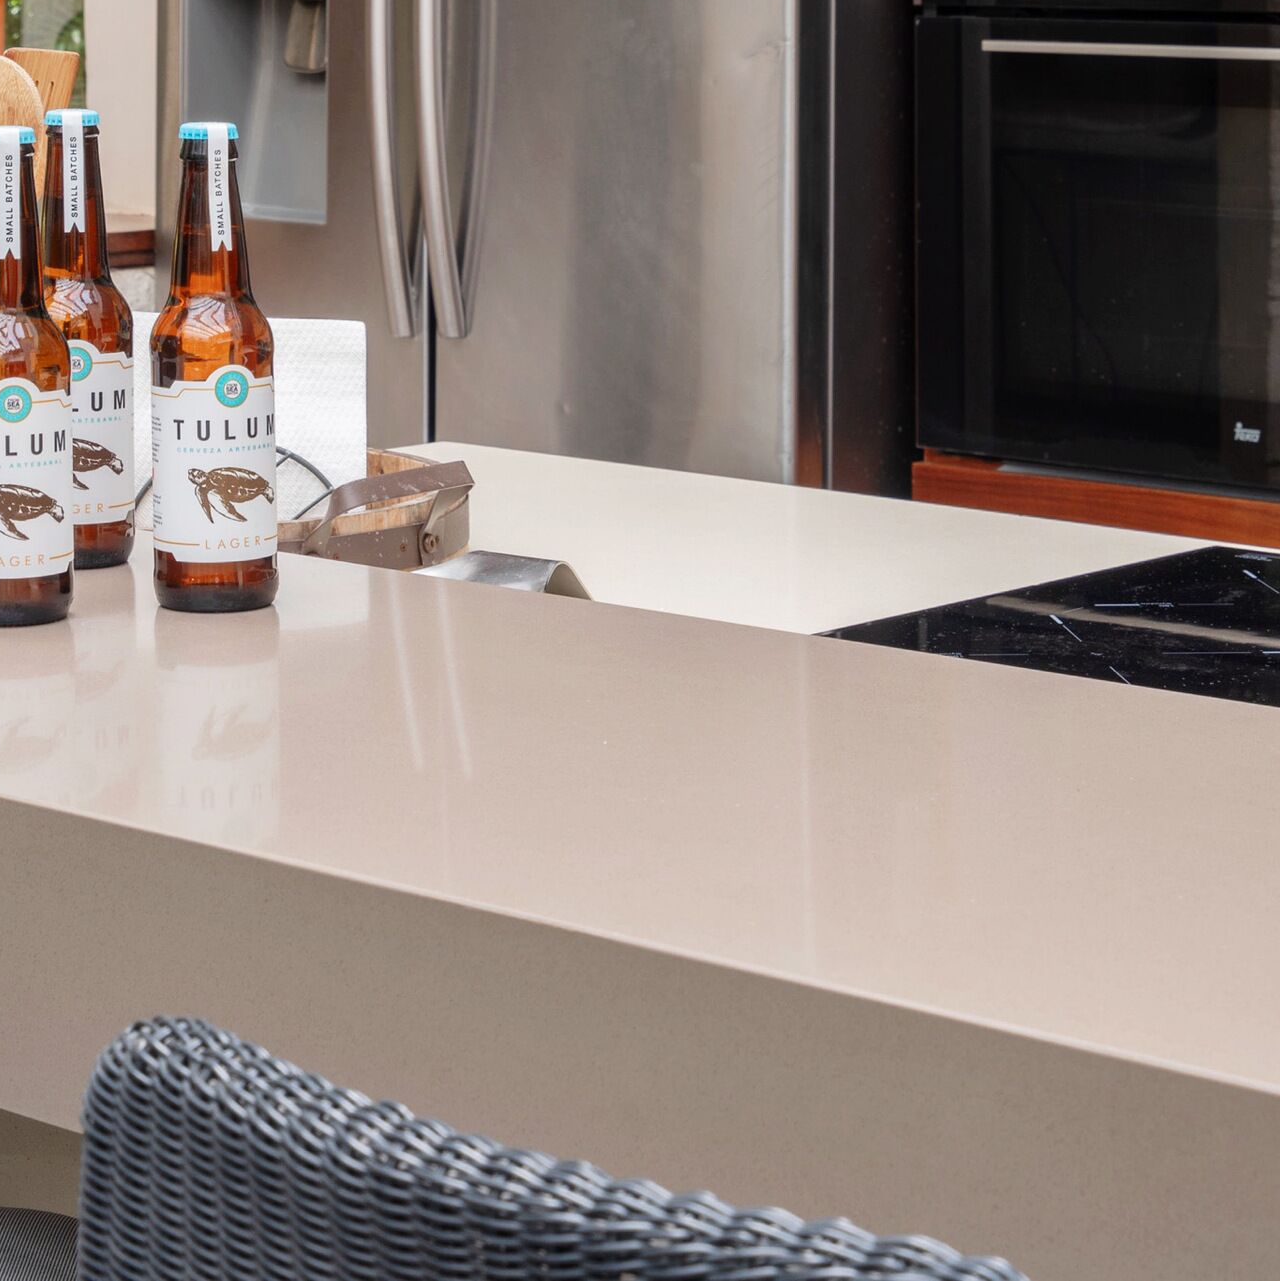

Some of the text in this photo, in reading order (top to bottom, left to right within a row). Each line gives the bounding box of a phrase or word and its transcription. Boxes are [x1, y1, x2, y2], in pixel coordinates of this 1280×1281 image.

[5, 154, 14, 243] SMALL BATCHES
[69, 136, 79, 218] SMALL BATCHES
[214, 149, 225, 236] SMALL BATCHES
[173, 413, 275, 441] TULUM
[9, 459, 63, 469] ARTESANAL
[205, 535, 261, 551] LAGER
